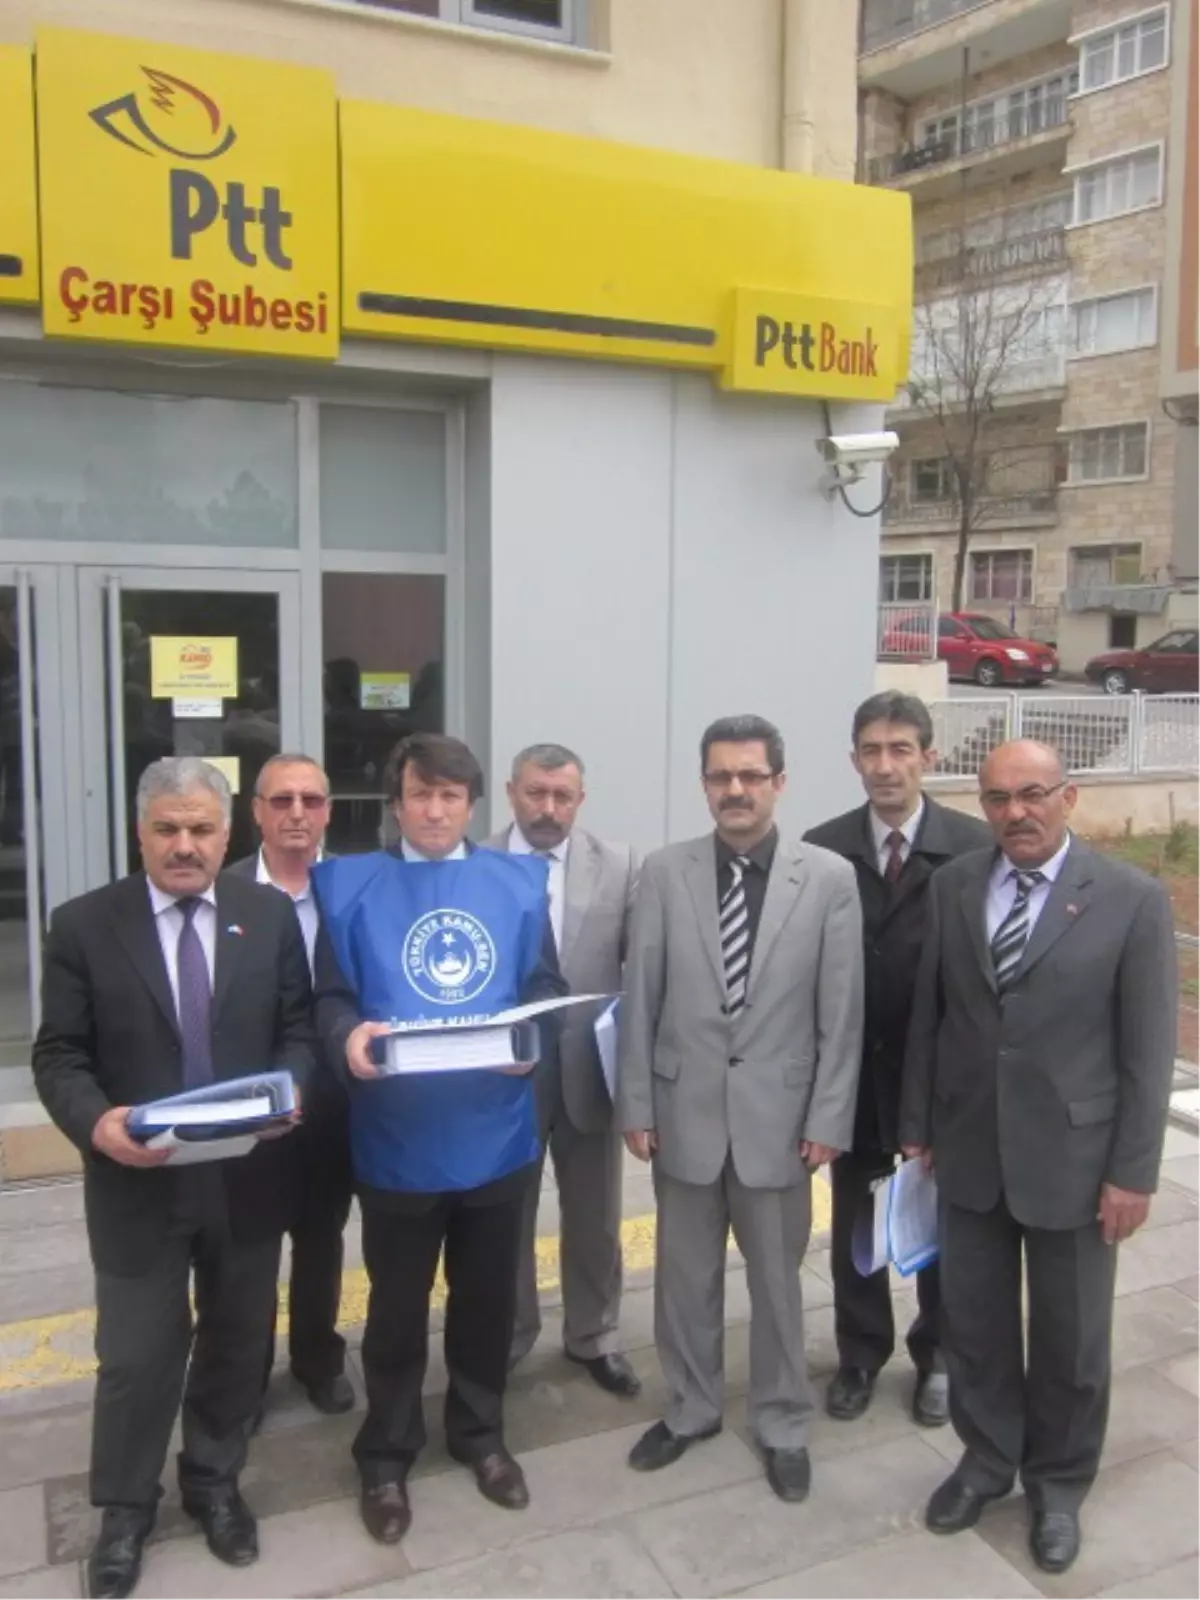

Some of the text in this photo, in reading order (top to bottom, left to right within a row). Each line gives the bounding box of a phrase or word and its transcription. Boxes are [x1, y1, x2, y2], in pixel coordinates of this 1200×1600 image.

[169, 167, 293, 271] Ptt
[58, 265, 328, 335] Çarşı Şubesi
